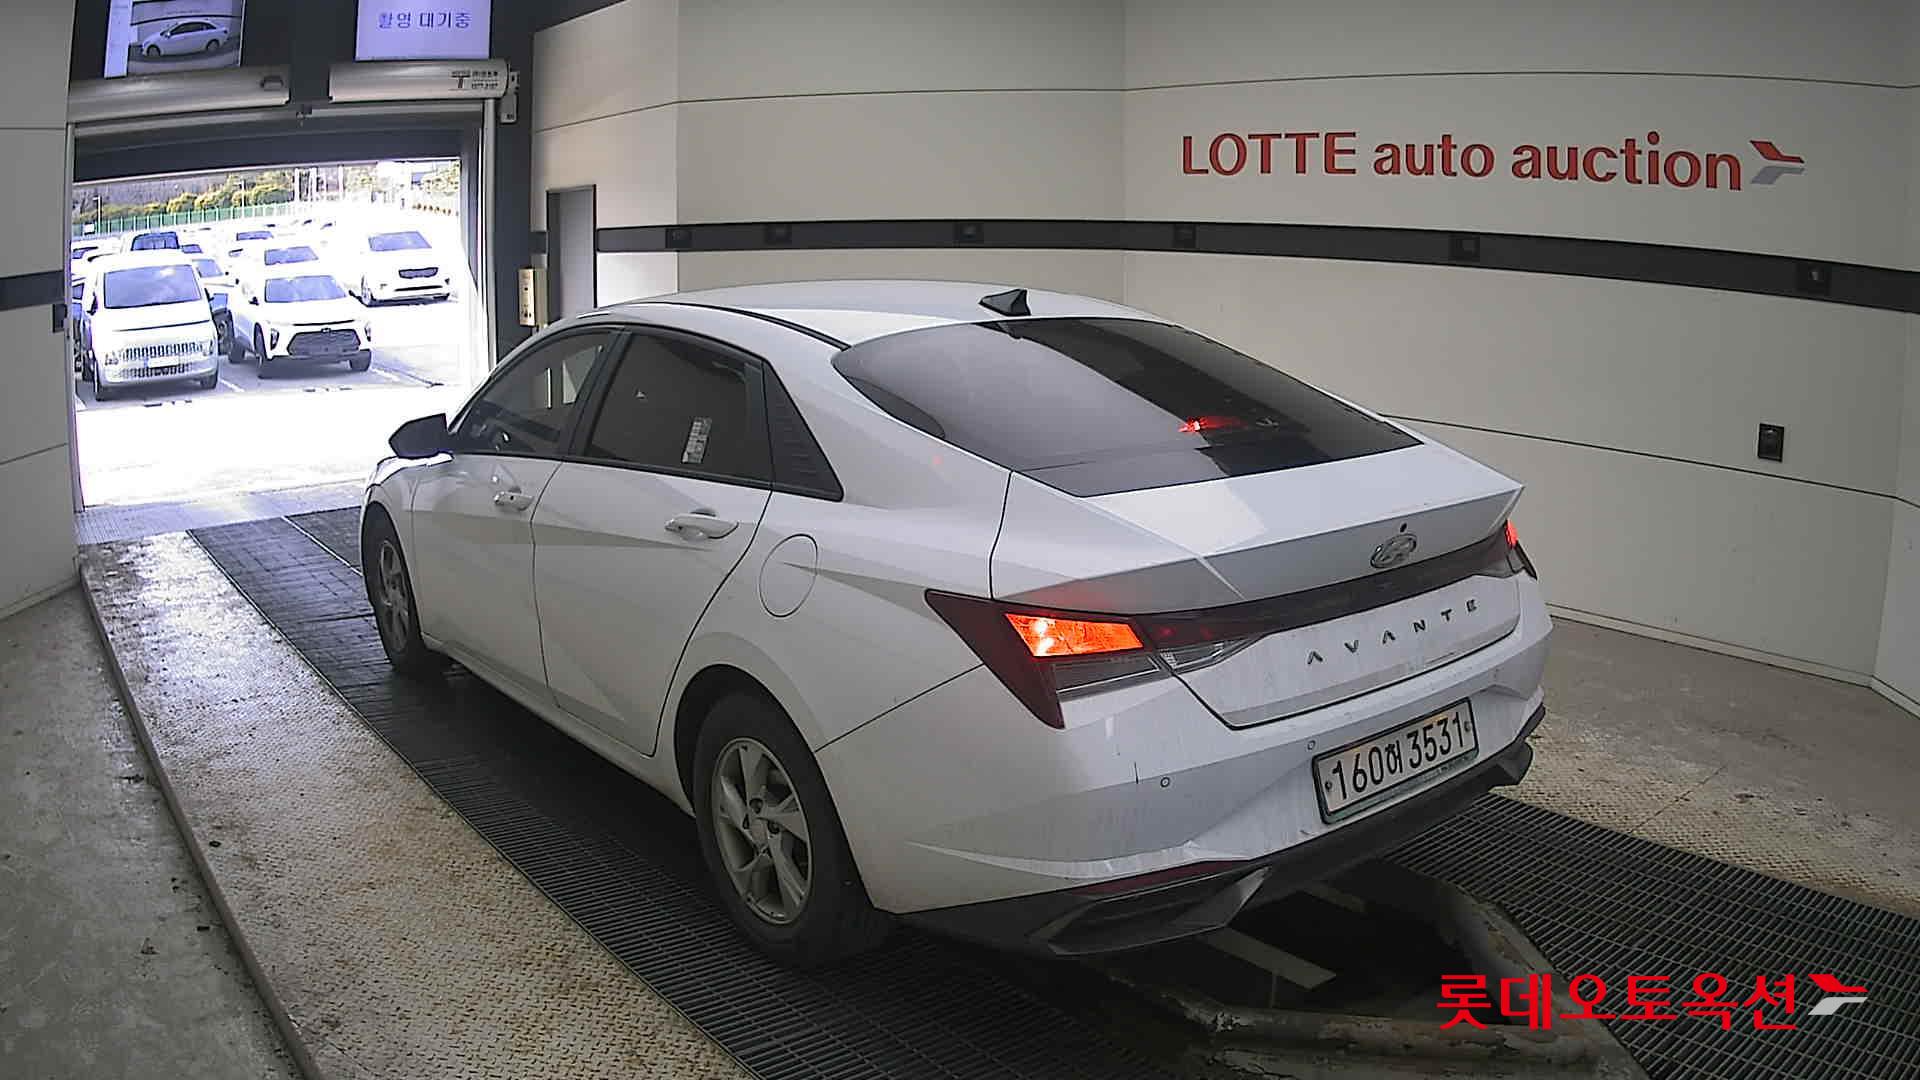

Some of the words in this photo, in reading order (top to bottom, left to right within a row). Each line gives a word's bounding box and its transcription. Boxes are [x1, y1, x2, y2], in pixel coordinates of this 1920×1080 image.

[419, 12, 472, 29] 대기중
[1183, 131, 1356, 176] LOTTE
[1373, 134, 1495, 178] auto
[1511, 130, 1742, 191] auction
[1306, 599, 1477, 665] AVANTE
[1408, 711, 1465, 769] 3531
